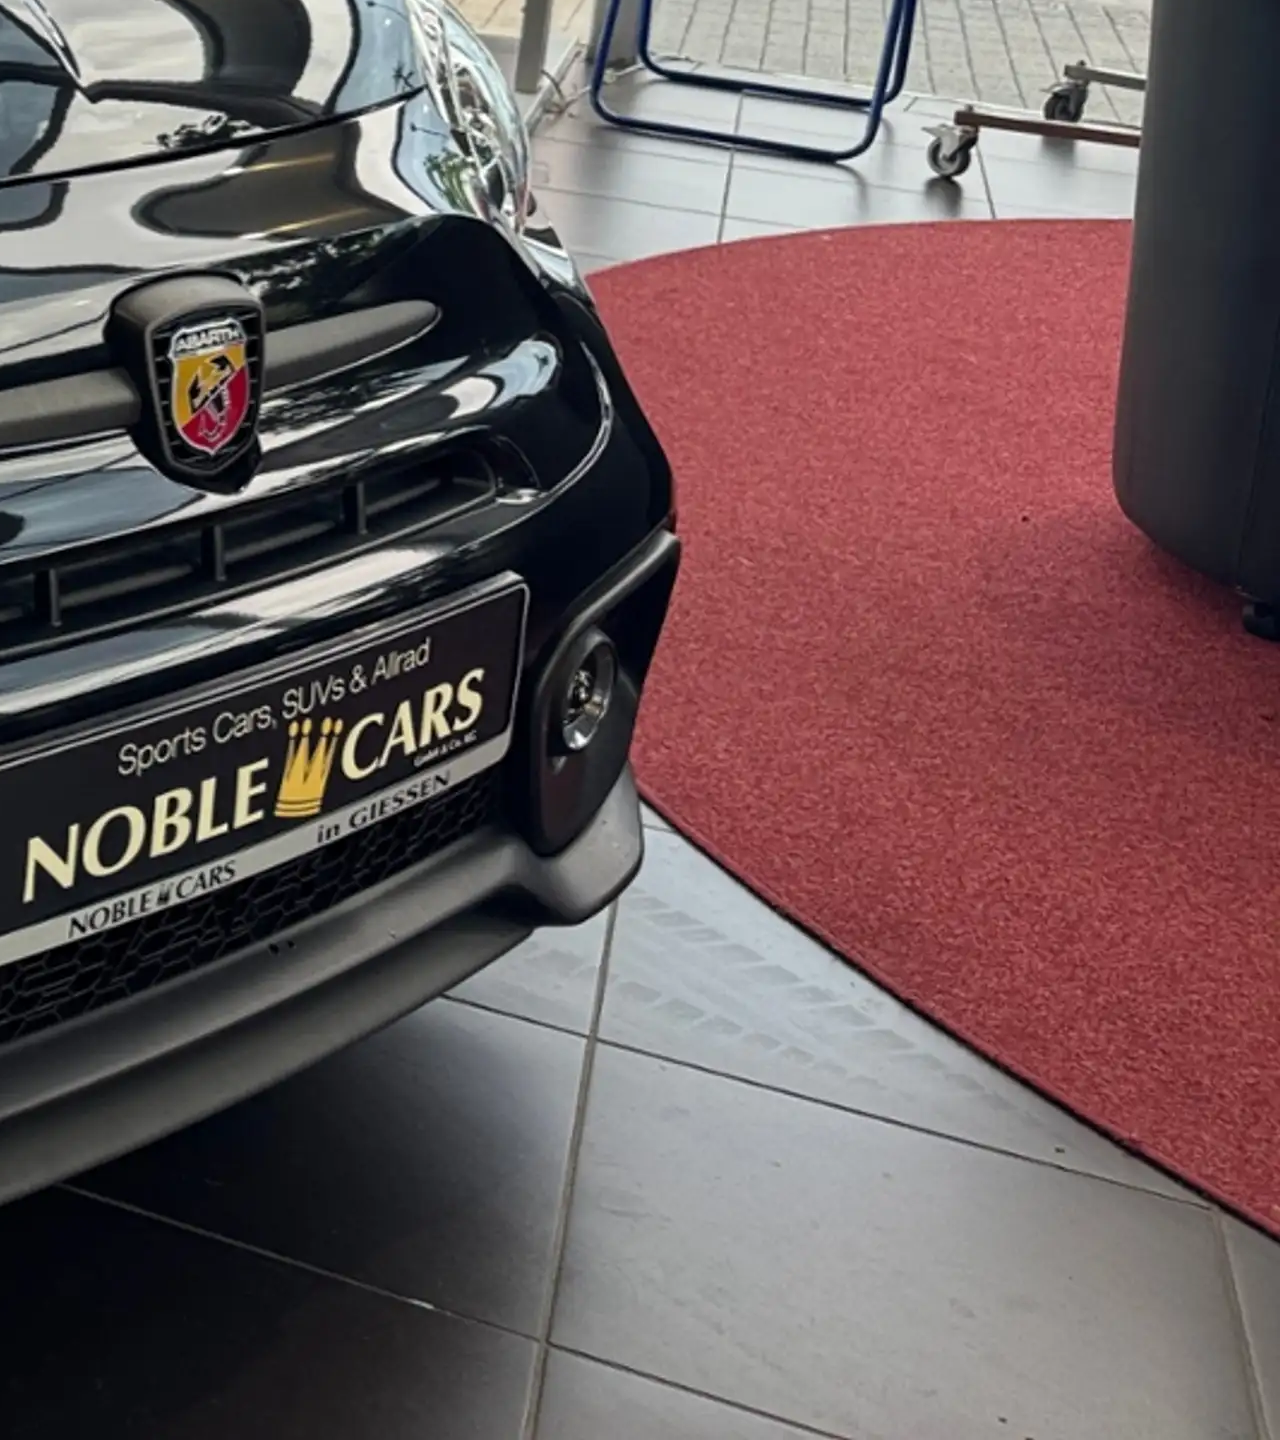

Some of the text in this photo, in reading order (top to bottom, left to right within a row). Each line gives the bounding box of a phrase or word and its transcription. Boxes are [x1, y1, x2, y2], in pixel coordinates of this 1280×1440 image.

[21, 666, 486, 905] NOBLE CARS
[117, 636, 432, 777] Sports Cars, SUVs & Allrad
[67, 769, 451, 940] NOBLE CARS in GIESSEN
